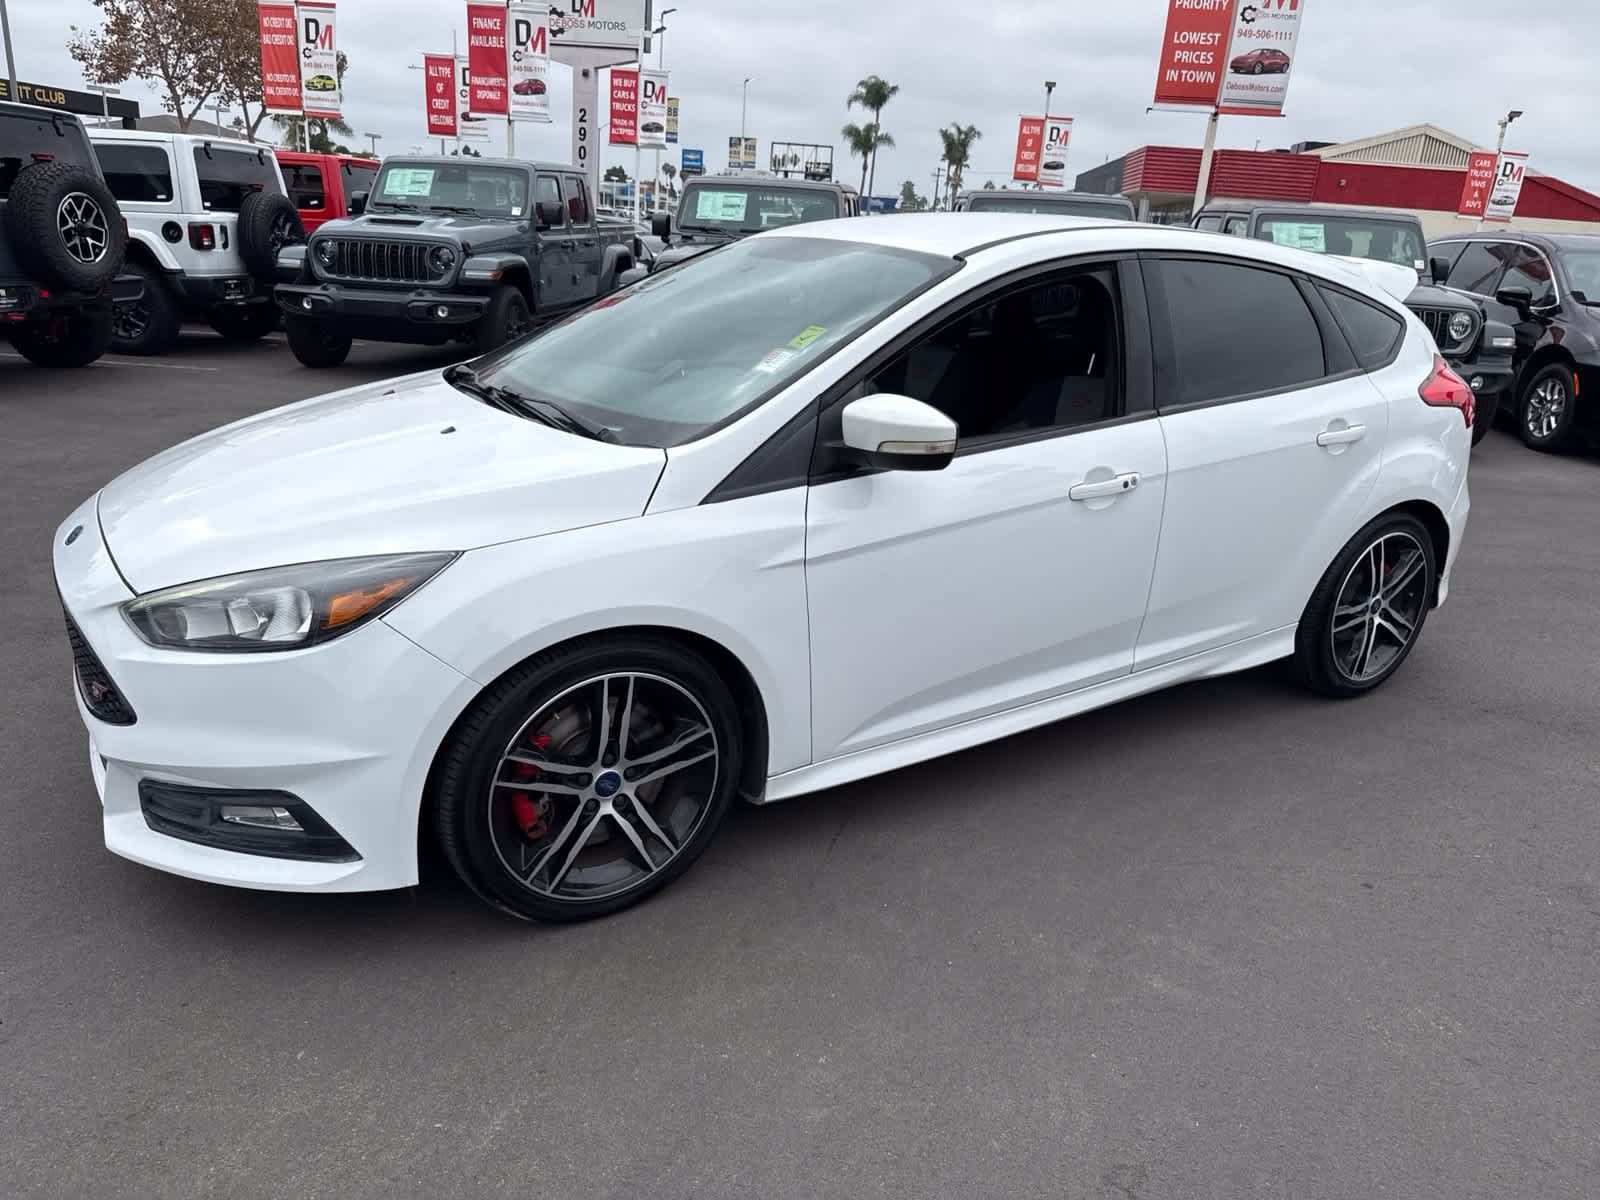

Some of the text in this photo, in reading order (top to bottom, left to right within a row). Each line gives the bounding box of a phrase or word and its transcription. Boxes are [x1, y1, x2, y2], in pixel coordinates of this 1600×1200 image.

[1175, 0, 1229, 10] PRIORITY
[472, 17, 501, 30] FINANCE
[587, 21, 626, 31] MOTORS
[304, 17, 333, 51] DM
[515, 18, 546, 54] DM
[1173, 31, 1222, 46] LOWEST
[1237, 29, 1293, 41] 949-506-1111
[470, 35, 505, 48] AVAILABLE
[1174, 50, 1214, 64] PRICES
[1166, 69, 1215, 83] IN TOWN
[623, 78, 636, 88] BUY
[1226, 81, 1285, 93] DebossMotors.com
[34, 88, 66, 105] CLUB
[613, 90, 629, 99] CARS
[643, 80, 666, 105] DM
[612, 102, 636, 112] TRUCKS
[1470, 169, 1492, 178] TRUCKS
